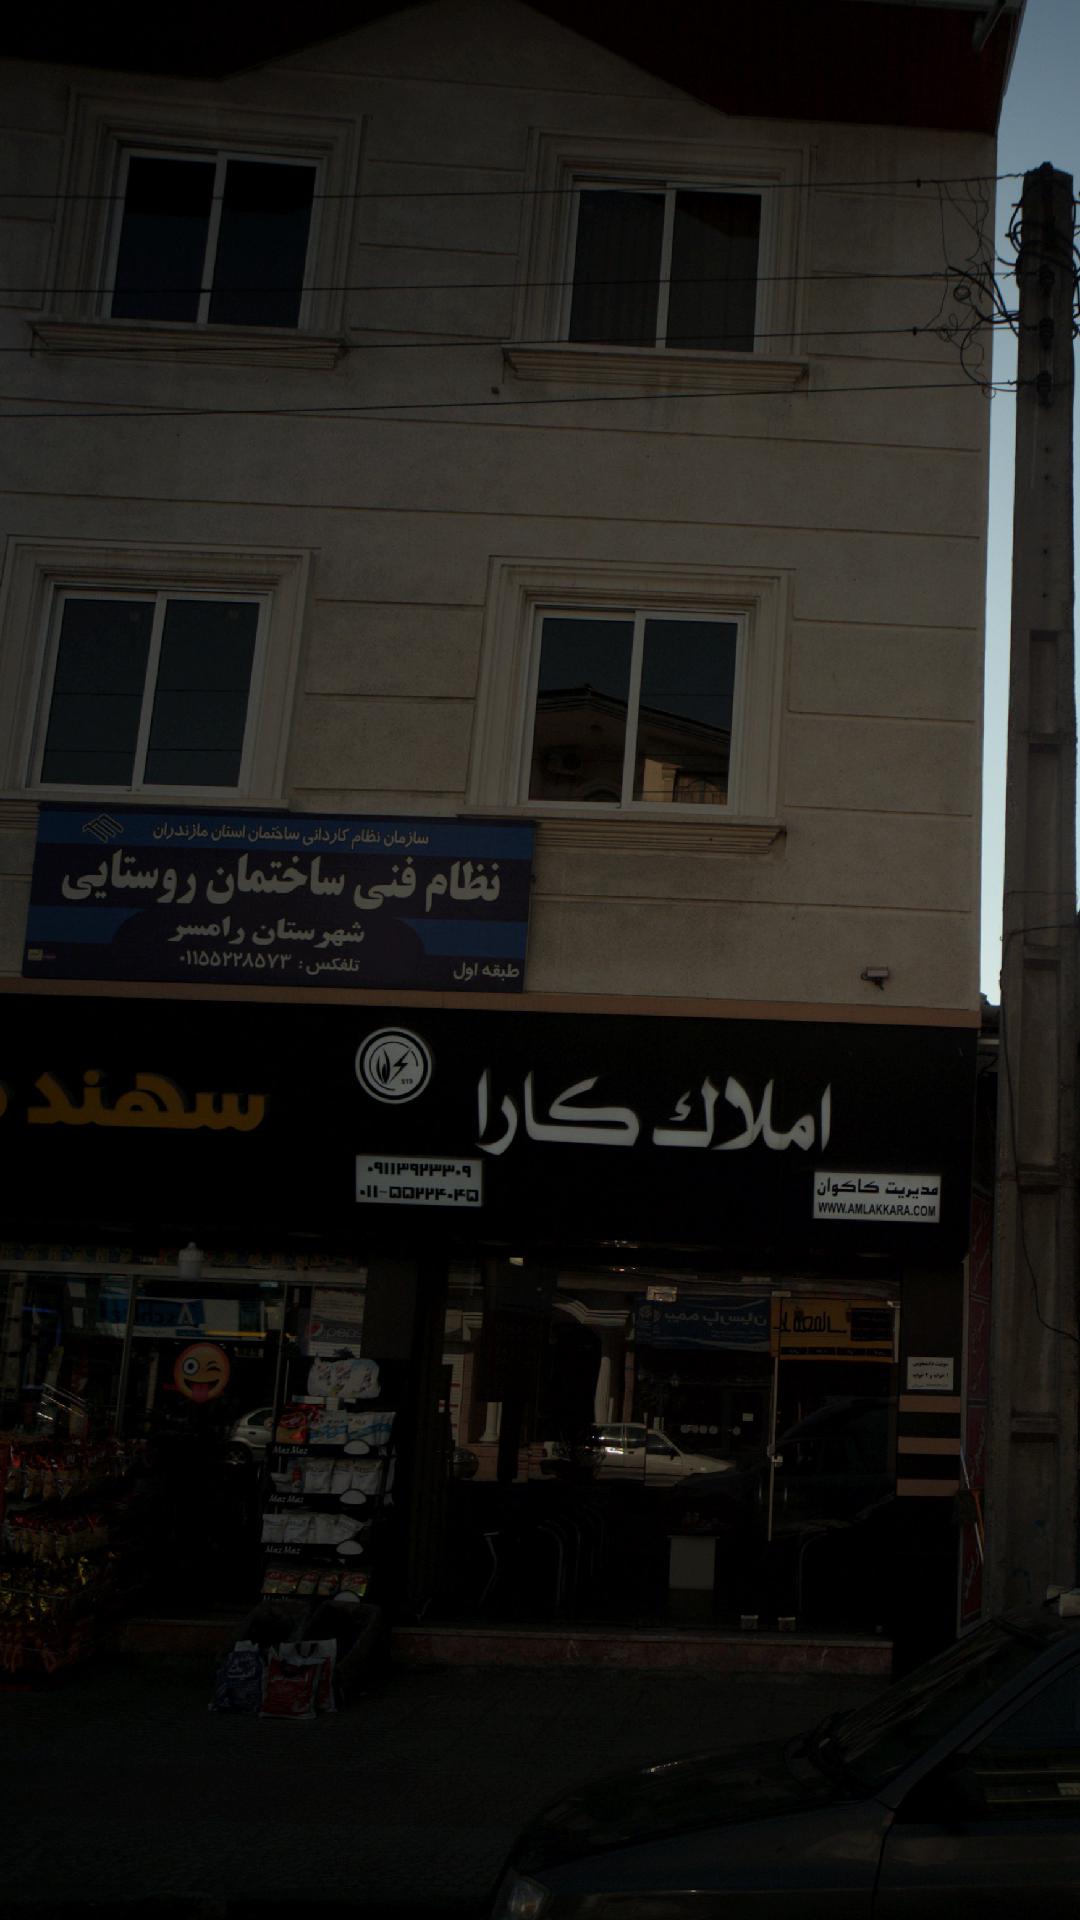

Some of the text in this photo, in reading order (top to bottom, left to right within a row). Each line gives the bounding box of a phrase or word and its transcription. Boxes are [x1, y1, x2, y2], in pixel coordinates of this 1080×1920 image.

[153, 821, 429, 850] سازمان نظام کاردانی ساختمان استان مازندران
[61, 848, 501, 912] نظام فنی ساختمان روستایی
[168, 915, 365, 948] شهرستان رامسر
[453, 962, 520, 981] طبقه اول
[27, 1068, 269, 1132] سهند
[474, 1067, 640, 1155] کارا
[816, 1177, 939, 1199] مدیریت کاکوان
[818, 1201, 936, 1218] WWW.AMLAKKARA.COM
